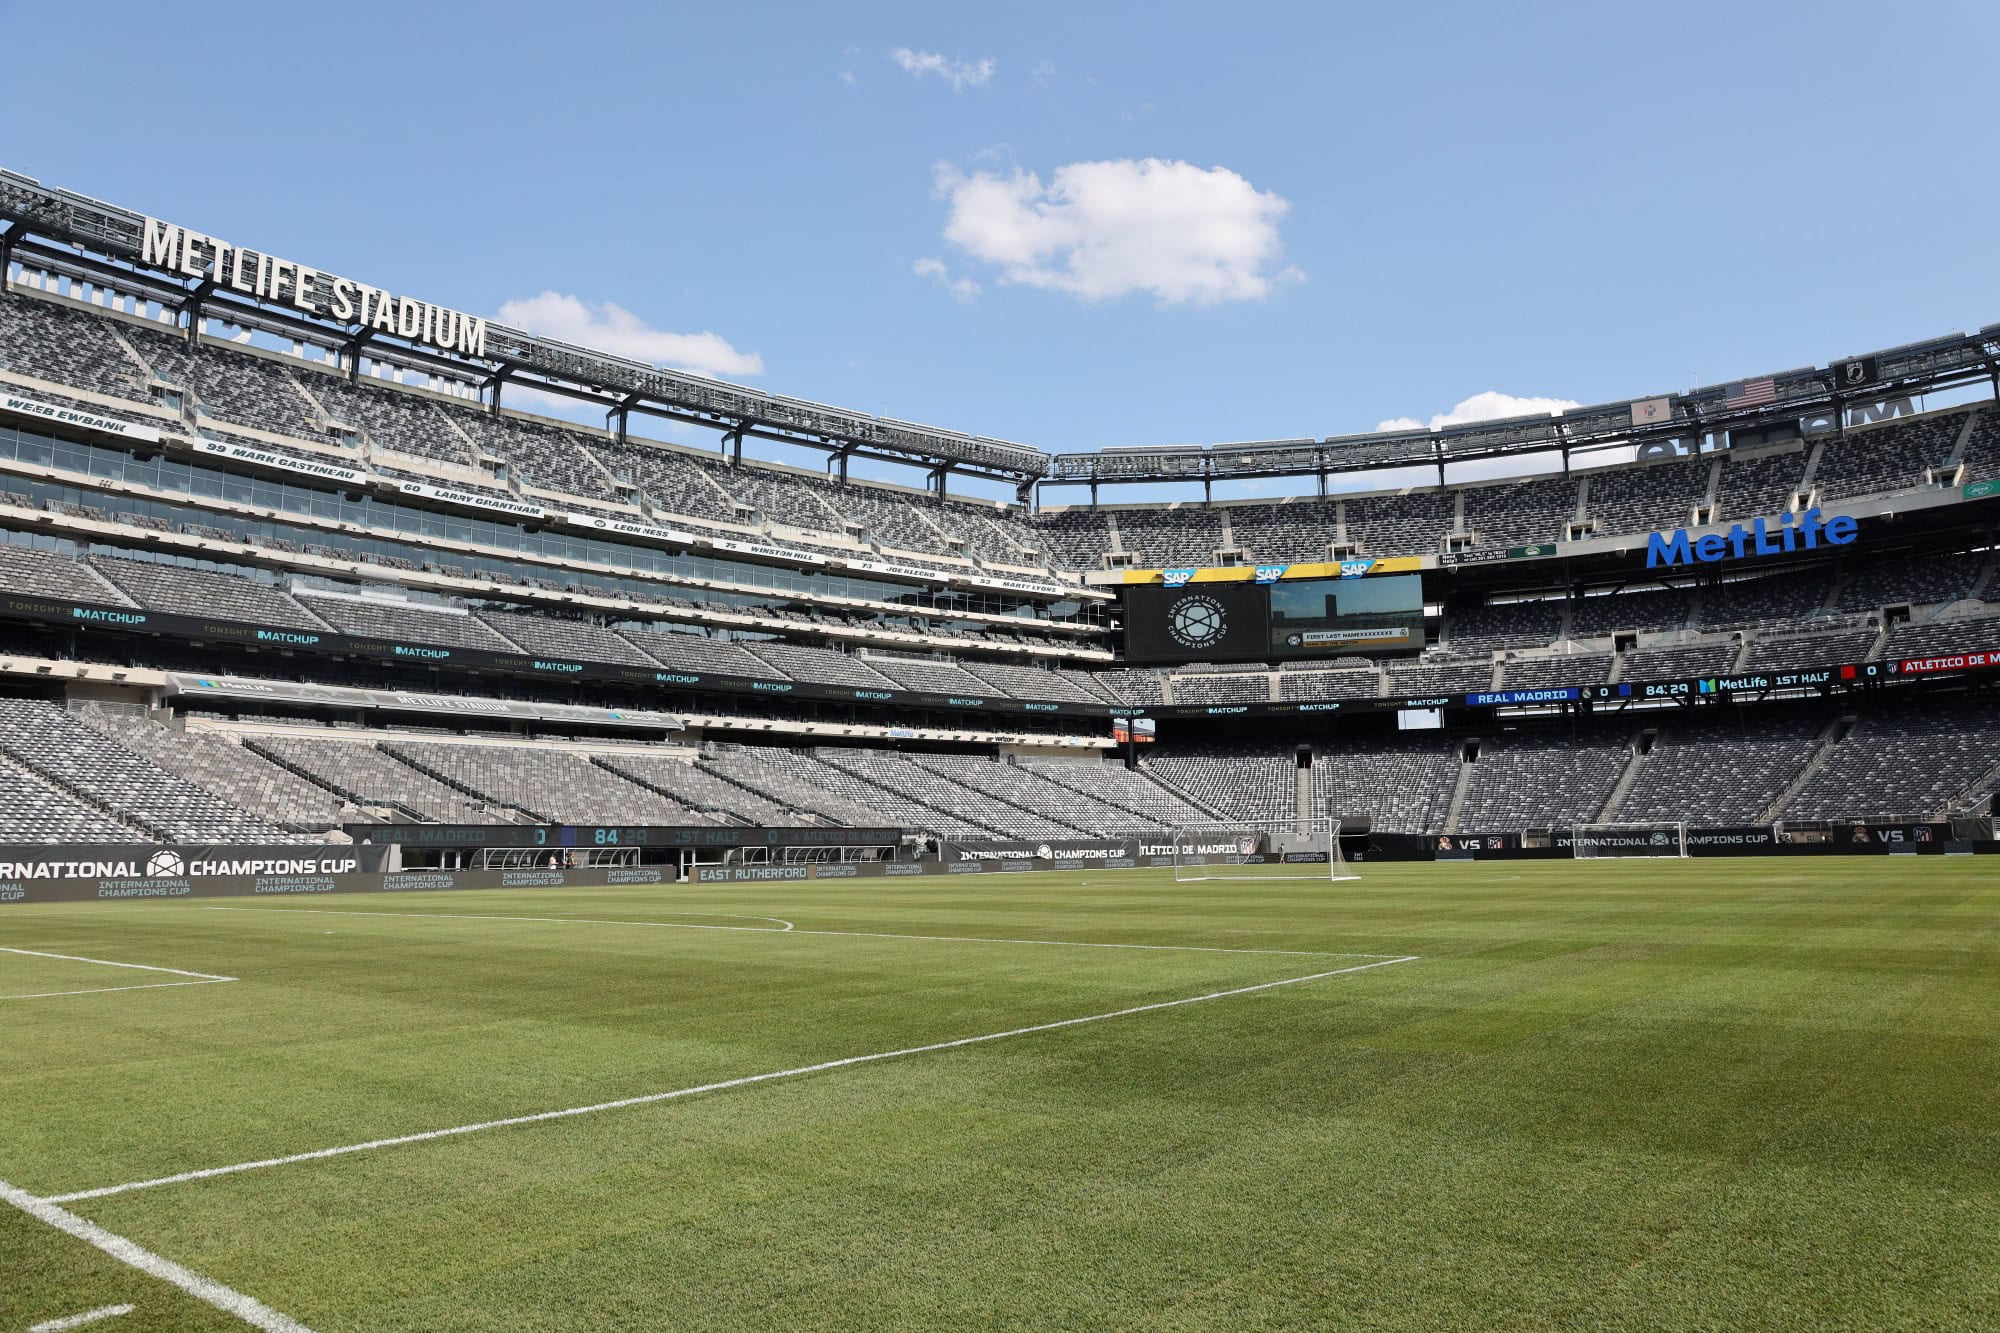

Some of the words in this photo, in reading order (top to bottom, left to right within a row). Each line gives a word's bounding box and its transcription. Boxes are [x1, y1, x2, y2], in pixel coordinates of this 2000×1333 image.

[141, 217, 317, 310] METLIFE
[331, 278, 485, 357] STADIUM
[7, 398, 54, 416] WEEB
[57, 410, 127, 433] EWBANK
[206, 443, 227, 453] 99
[232, 448, 277, 464] MARK
[279, 458, 355, 481] GASTINEAU
[435, 490, 473, 505] LARRY
[475, 498, 541, 515] GRANTHAM
[613, 523, 641, 534] LEON
[1646, 507, 1858, 568] MetLife
[751, 546, 793, 558] WINSTON
[794, 552, 814, 561] HILL
[886, 566, 903, 574] JOE
[903, 568, 936, 578] KLECKO
[1256, 569, 1282, 581] SAP
[1341, 564, 1368, 576] SAP
[1163, 573, 1190, 584] SAP
[1002, 581, 1031, 590] MARTY
[1031, 585, 1057, 593] LYONS
[9, 601, 73, 616] TONIGHT'S
[78, 610, 146, 624] MATCHUP
[1168, 595, 1227, 619] INTERNATIONAL
[263, 630, 319, 645] MATCHUP
[1168, 625, 1216, 648] CHAMPIONS
[1217, 624, 1227, 639] CUP
[401, 647, 450, 659] MATCHUP
[1968, 655, 1985, 665] DE
[538, 661, 582, 673] MATCHUP
[659, 673, 699, 684] MATCHUP
[1720, 677, 1767, 690] MetLife
[1776, 675, 1798, 685] 1ST
[1801, 672, 1830, 683] HALF
[220, 682, 274, 692] MetLife
[756, 682, 792, 692] MATCHUP
[1646, 683, 1689, 696] 84:29
[858, 691, 892, 700] MATCHUP
[1479, 694, 1508, 703] REAL
[1514, 691, 1567, 702] MADRID
[396, 695, 454, 708] METLIFE
[457, 701, 512, 712] STADIUM
[952, 698, 983, 706] MATCHUP
[1302, 704, 1339, 712] MATCHUP
[1409, 698, 1448, 708] MATCHUP
[1211, 707, 1247, 715] MATCHUP
[995, 735, 1015, 743] verizon
[372, 829, 411, 842] REAL
[420, 829, 485, 842] MADRID
[675, 831, 700, 843] 1ST
[706, 831, 740, 843] HALF
[1556, 837, 1648, 847] INTERNATIONAL
[1745, 834, 1769, 844] CUP
[1878, 830, 1904, 842] VS
[1182, 845, 1194, 855] DE
[1198, 844, 1237, 854] MADRID
[1459, 839, 1481, 850] VS
[960, 850, 1037, 861] INTERNATIONAL
[1054, 850, 1107, 859] CHAMPIONS
[1109, 849, 1126, 858] CUP
[189, 860, 317, 876] CHAMPIONS
[320, 859, 357, 874] CUP
[700, 870, 731, 880] EAST
[736, 867, 807, 879] RUTHERFORD
[255, 877, 335, 885] INTERNATIONAL
[383, 874, 453, 883] INTERNATIONAL
[502, 878, 550, 886] CHAMPIONS
[503, 872, 563, 880] INTERNATIONAL
[100, 880, 191, 889] INTERNATIONAL
[255, 885, 315, 893] CHAMPIONS
[383, 881, 437, 889] CHAMPIONS
[99, 889, 167, 897] CHAMPIONS
